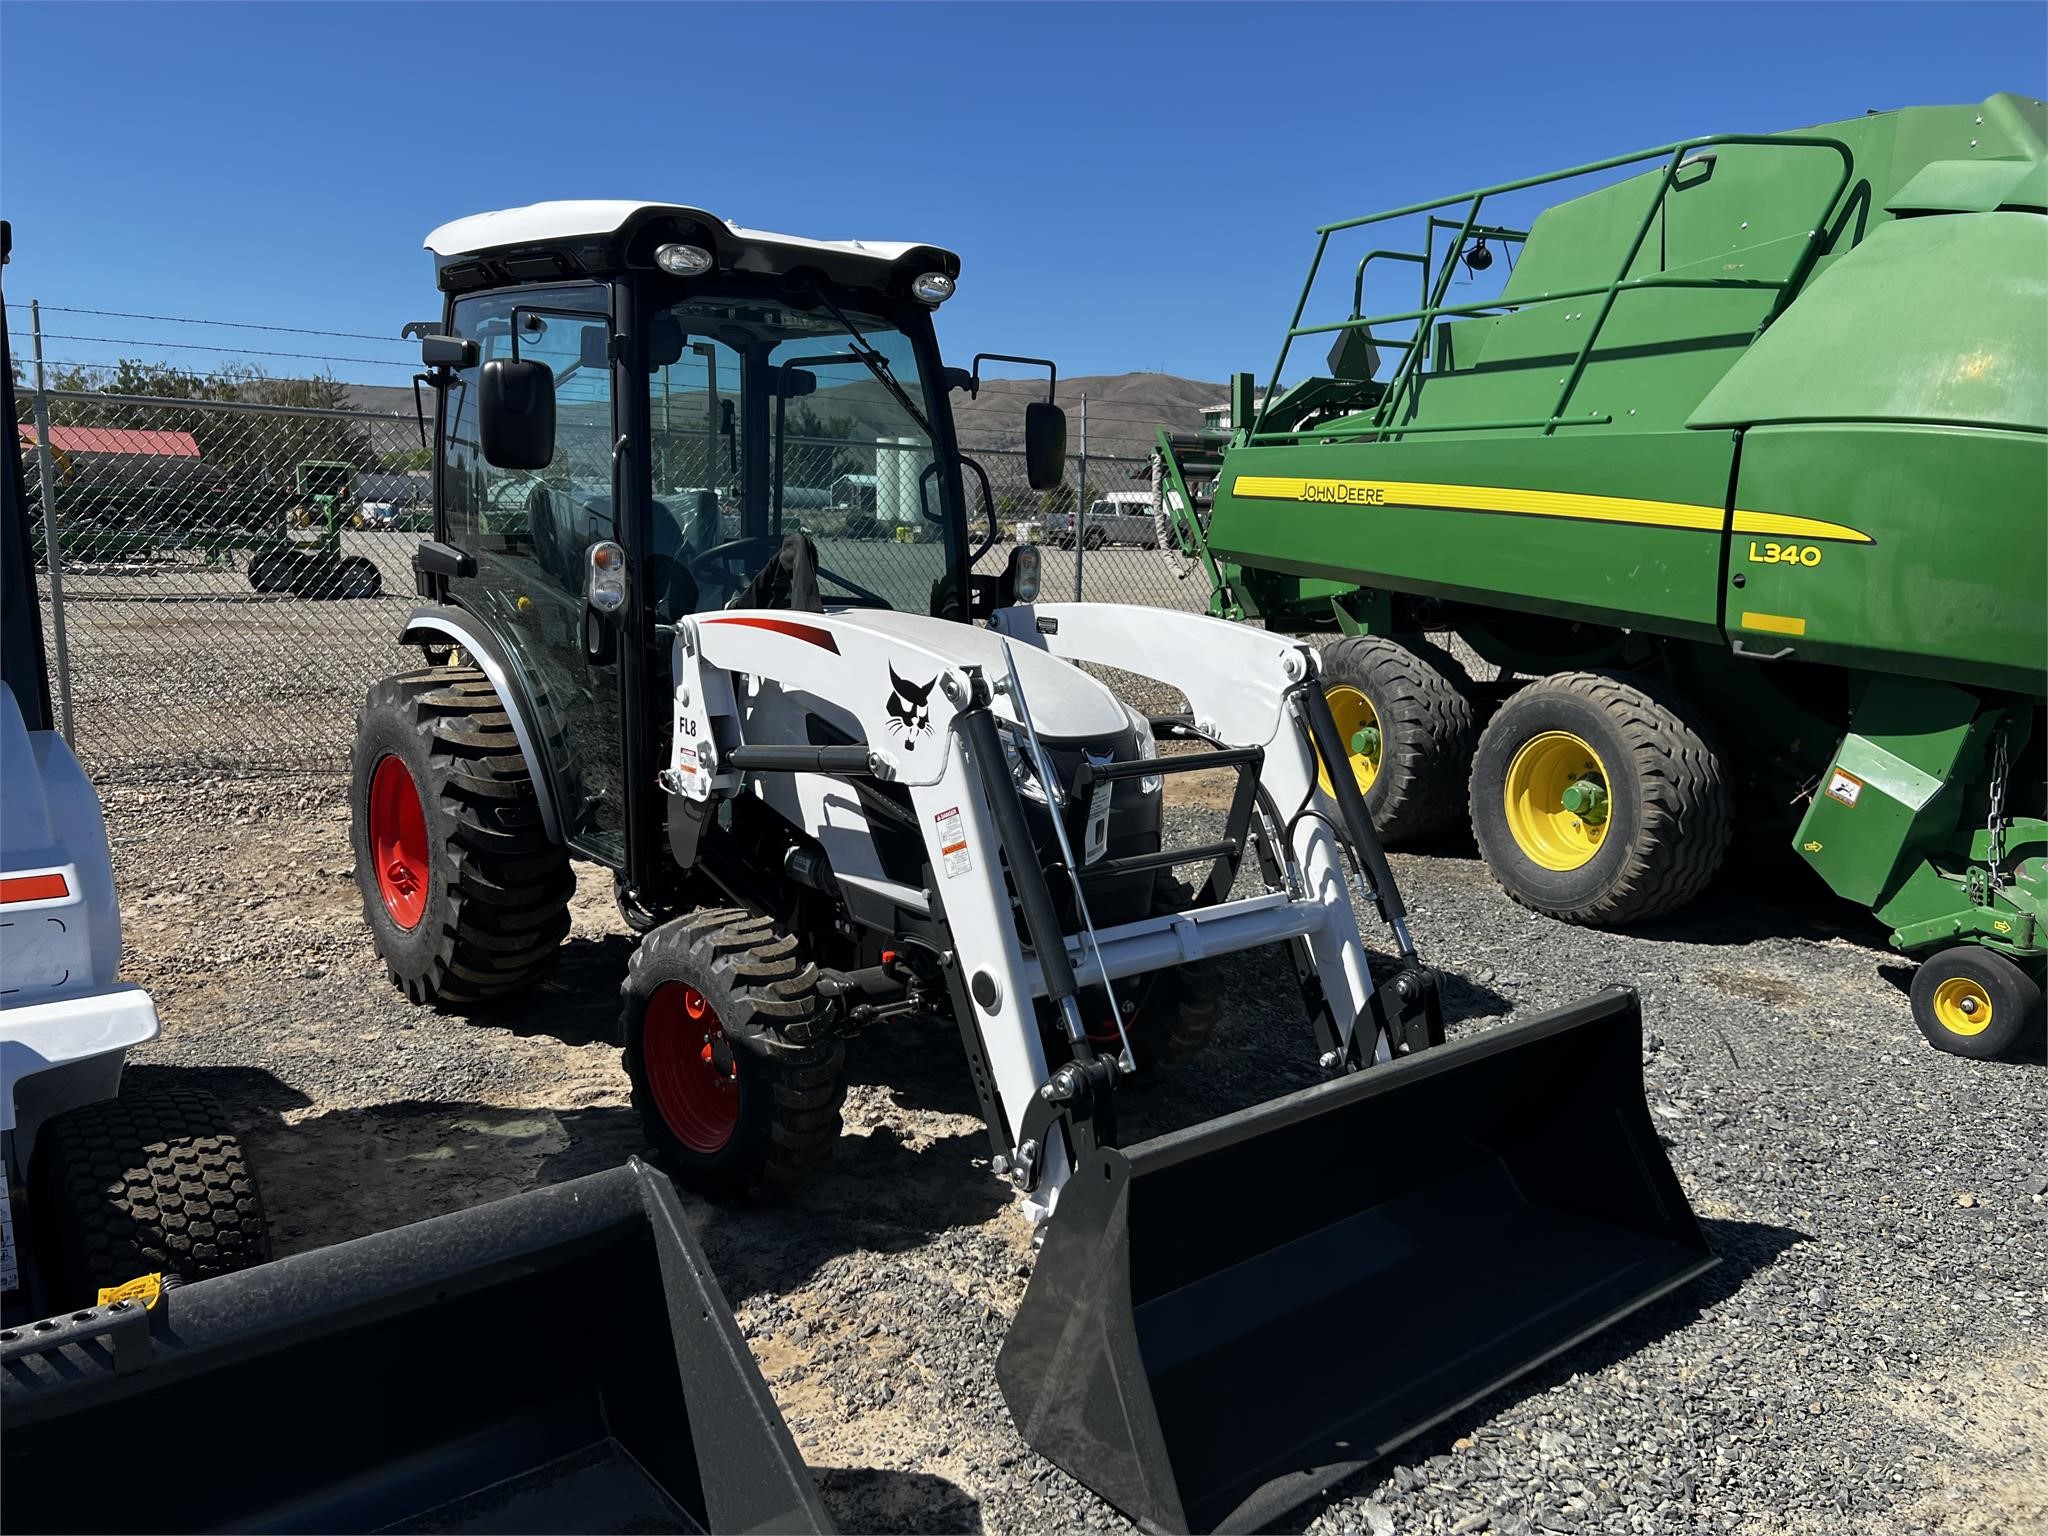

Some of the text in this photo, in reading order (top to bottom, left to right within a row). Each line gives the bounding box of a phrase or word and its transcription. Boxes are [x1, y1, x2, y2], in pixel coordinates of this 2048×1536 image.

[1300, 483, 1384, 502] JOHN DEERE
[1749, 541, 1822, 566] L340
[679, 716, 697, 737] FL8
